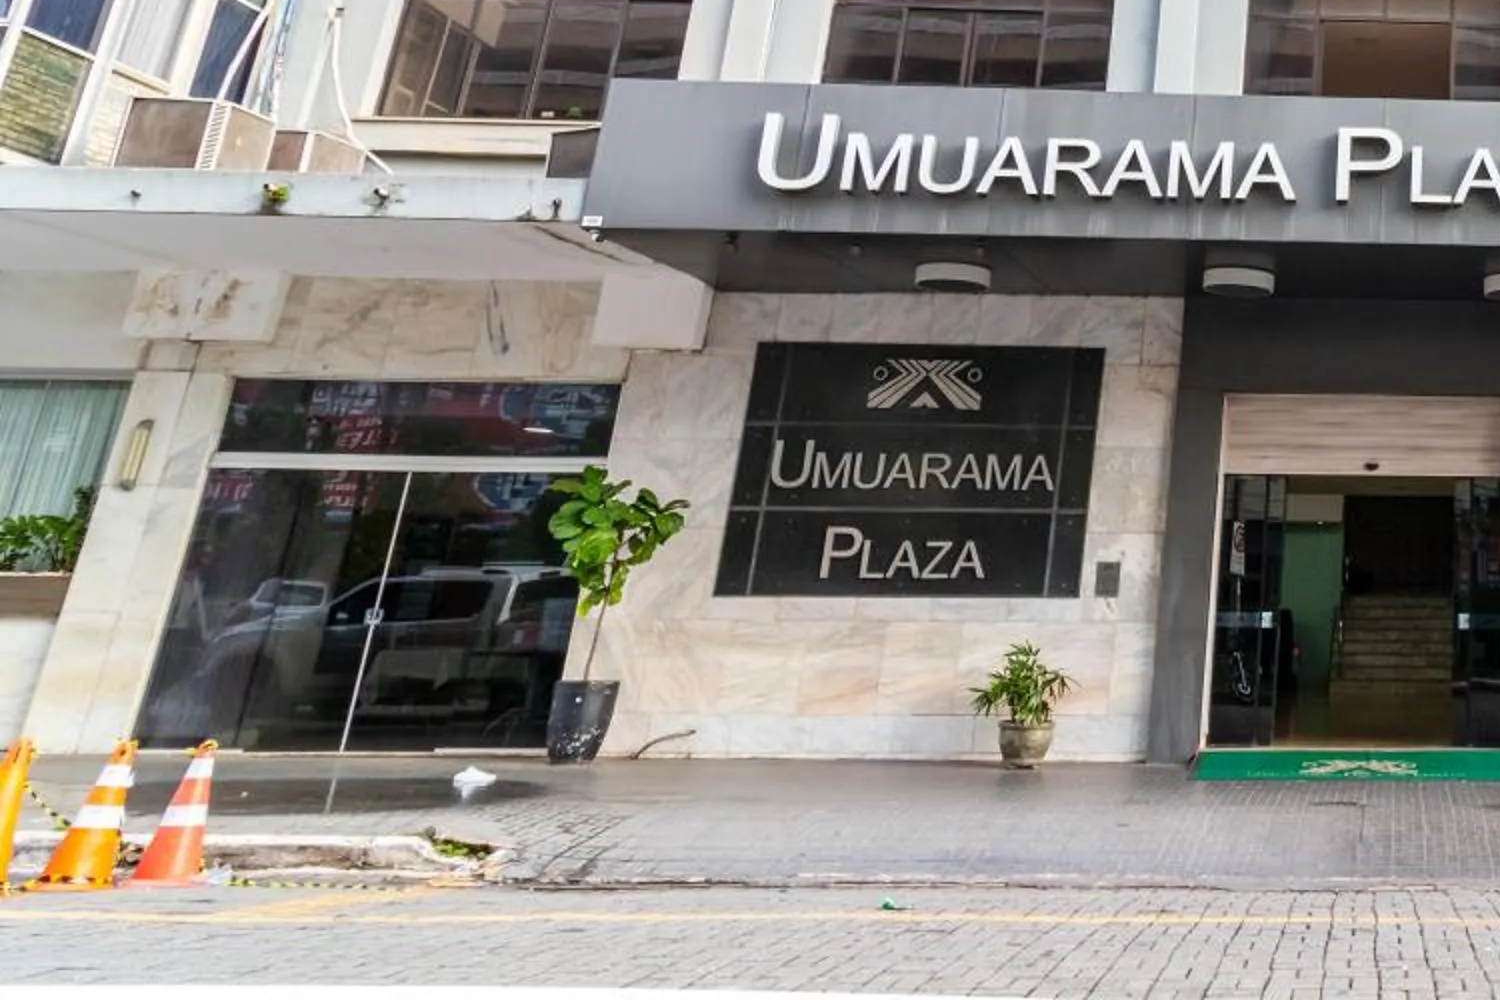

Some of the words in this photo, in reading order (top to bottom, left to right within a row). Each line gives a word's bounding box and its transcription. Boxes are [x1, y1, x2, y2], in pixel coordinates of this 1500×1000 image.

[757, 112, 1296, 202] UMUARAMA
[770, 439, 1055, 492] UMUARAMA
[818, 526, 985, 580] PLAZA
